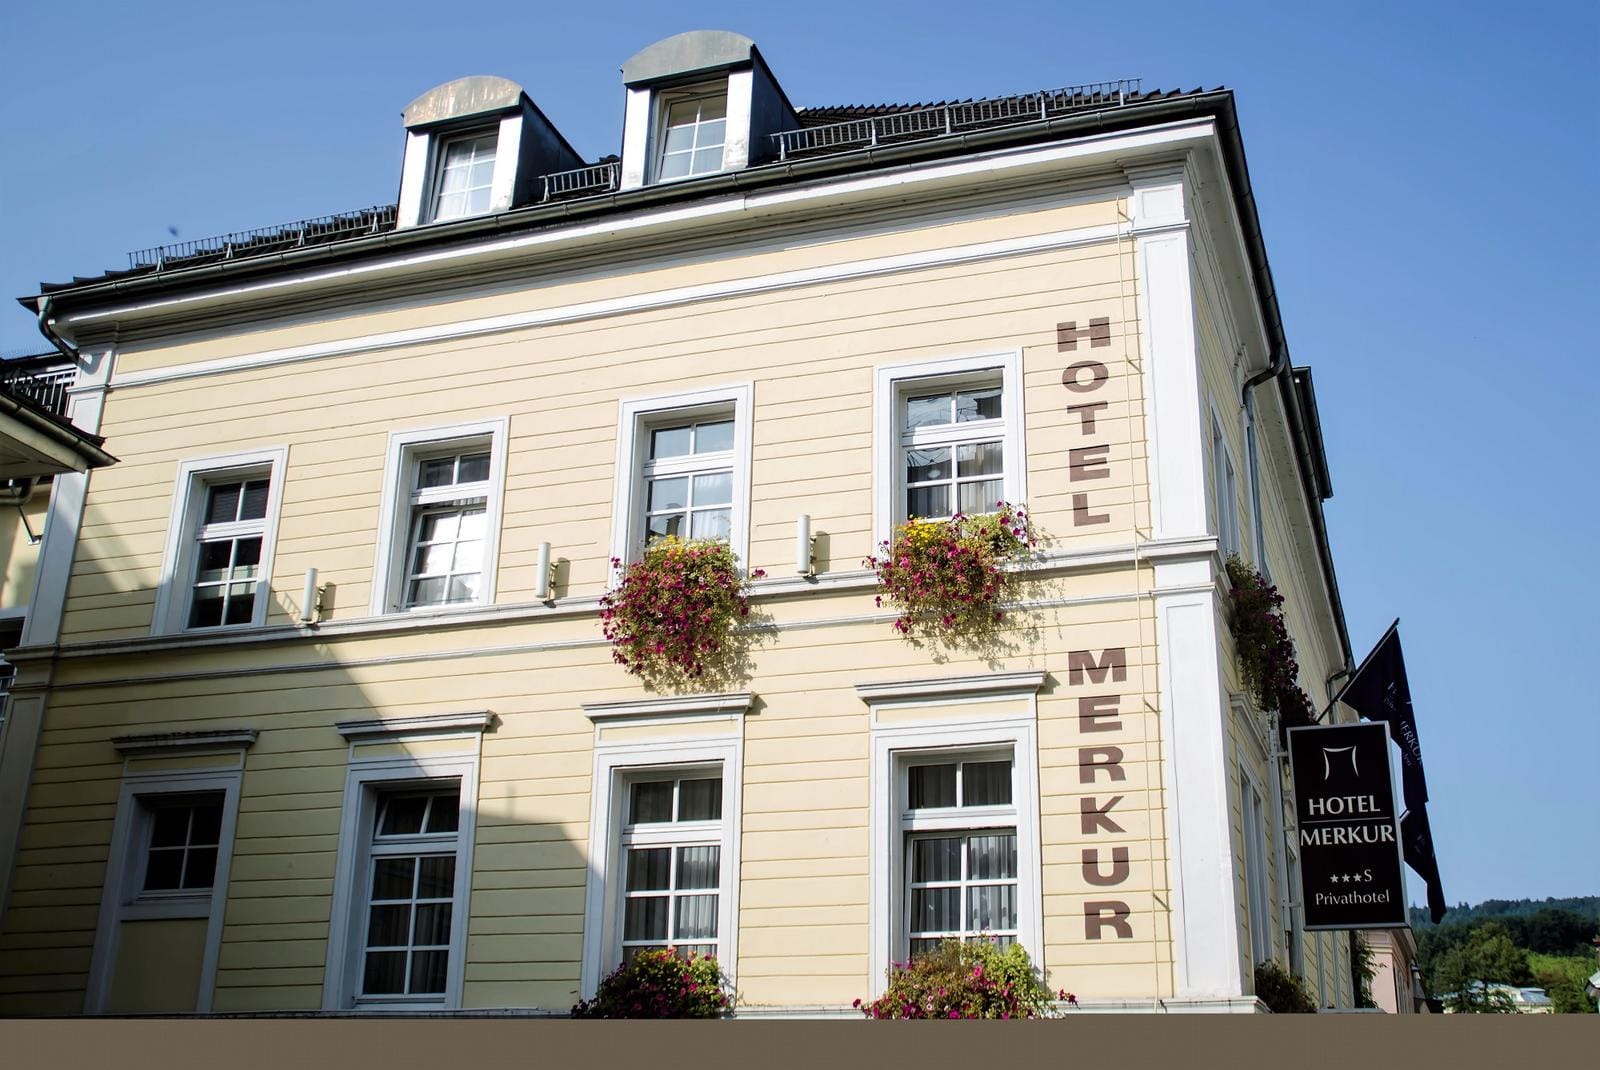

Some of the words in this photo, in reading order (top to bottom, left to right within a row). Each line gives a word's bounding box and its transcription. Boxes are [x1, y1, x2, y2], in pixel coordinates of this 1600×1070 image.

[1057, 317, 1111, 527] HOTEL
[1068, 647, 1133, 940] MERKUR
[1308, 795, 1381, 816] HOTEL
[1300, 824, 1395, 846] MERKUR
[1315, 888, 1390, 906] Privathotel
